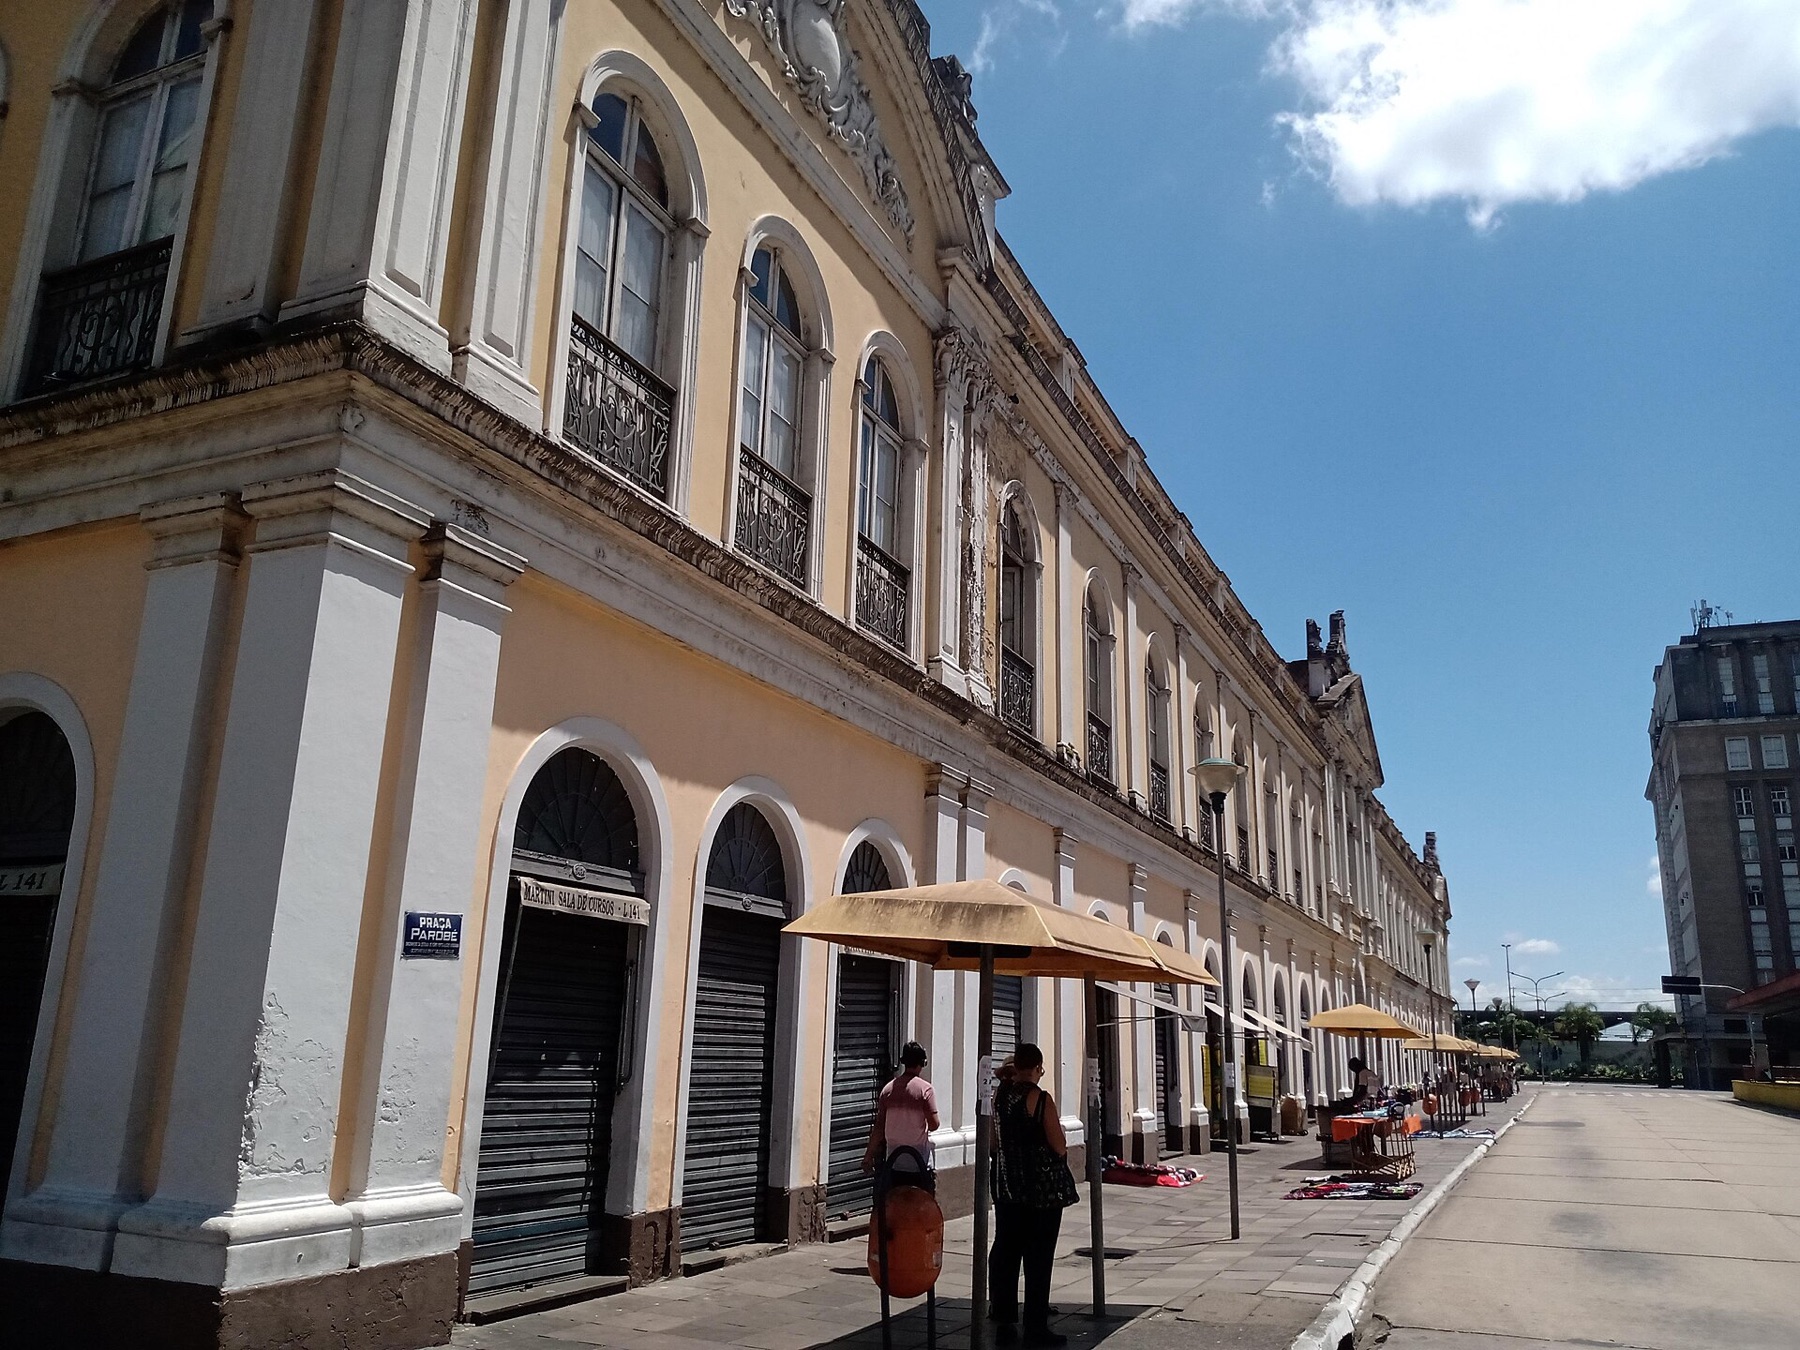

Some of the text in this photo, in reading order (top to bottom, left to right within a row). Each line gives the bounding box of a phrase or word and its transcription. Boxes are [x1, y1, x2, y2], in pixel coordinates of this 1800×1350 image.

[12, 872, 47, 890] 141
[523, 881, 555, 906] MARTINI
[558, 891, 576, 910] SALA
[577, 893, 588, 911] DE
[588, 896, 615, 917] CURSOS
[629, 903, 641, 920] 141
[420, 917, 452, 931] PRAÇA
[410, 928, 459, 942] PAROBÉ
